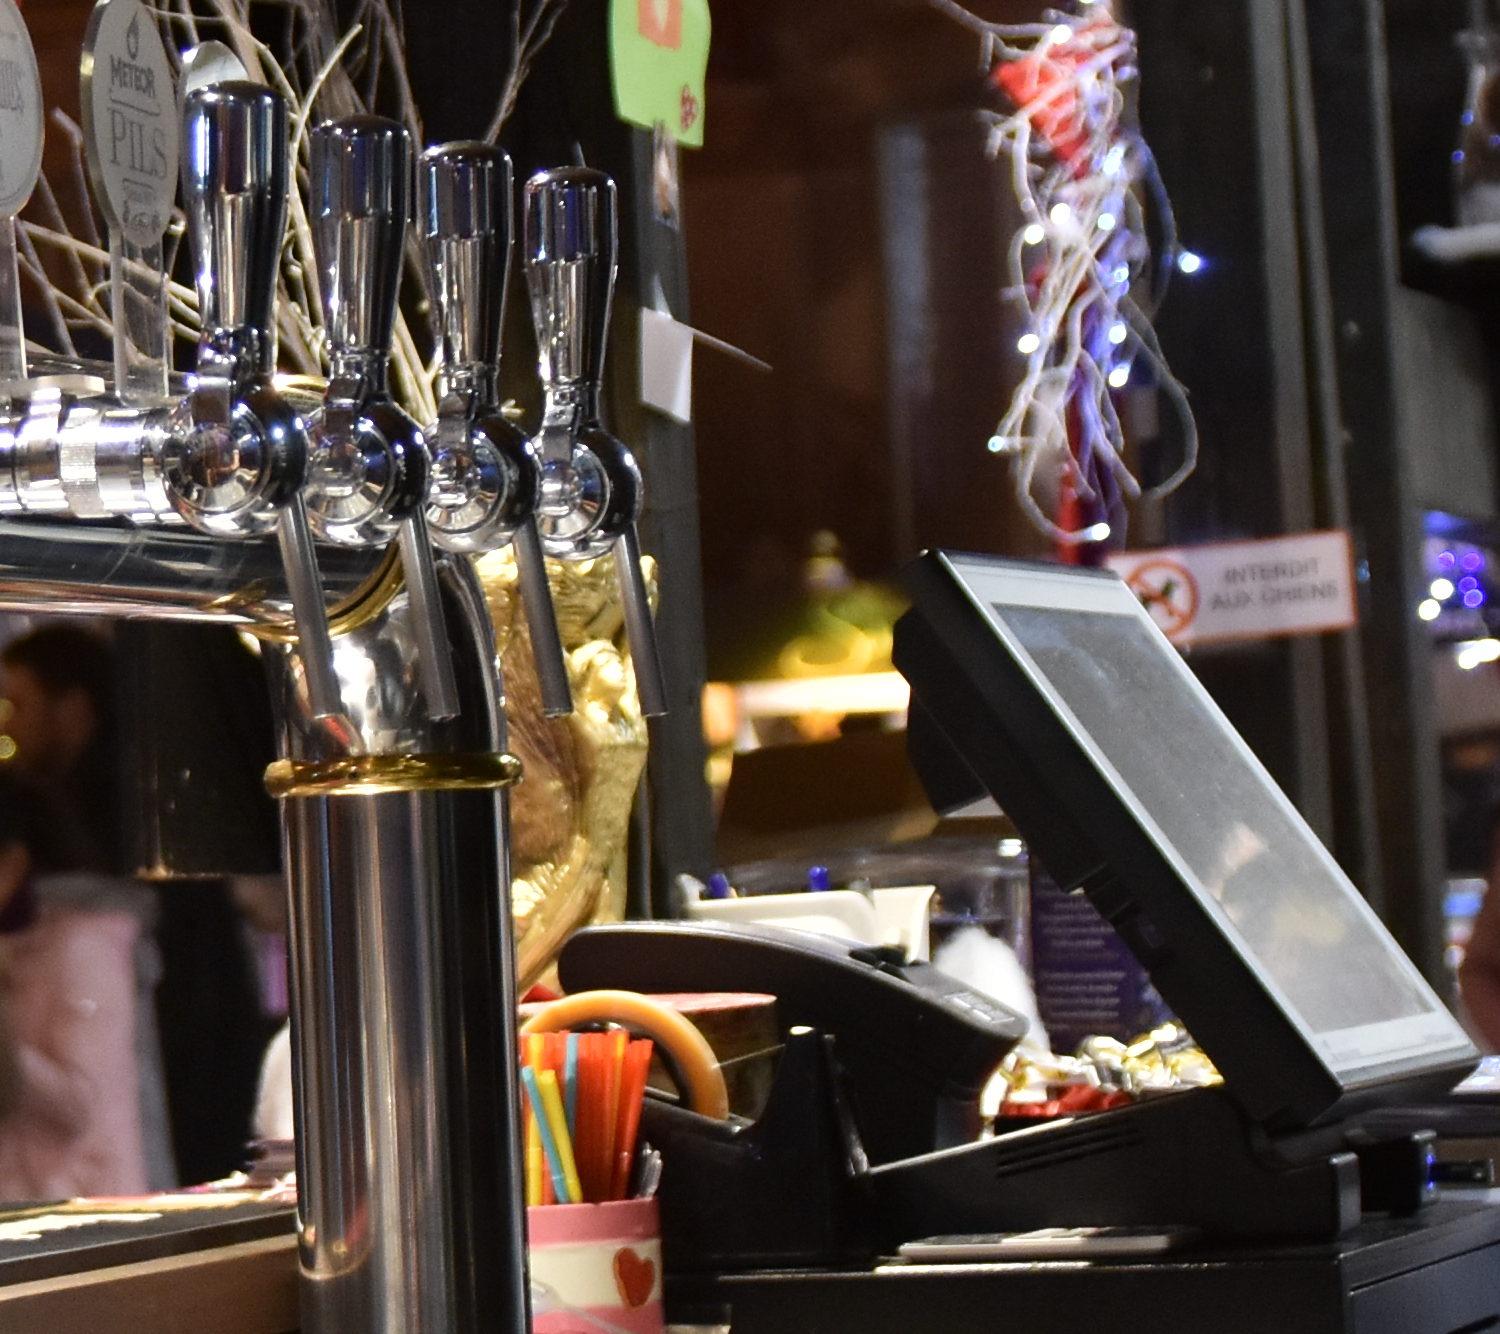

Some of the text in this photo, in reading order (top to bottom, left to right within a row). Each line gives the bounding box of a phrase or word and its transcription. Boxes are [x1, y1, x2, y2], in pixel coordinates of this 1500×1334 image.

[110, 55, 156, 100] METEOR
[107, 107, 168, 182] PILS
[1224, 557, 1319, 583] INTERDIT
[1210, 582, 1340, 611] AUX CHIENS
